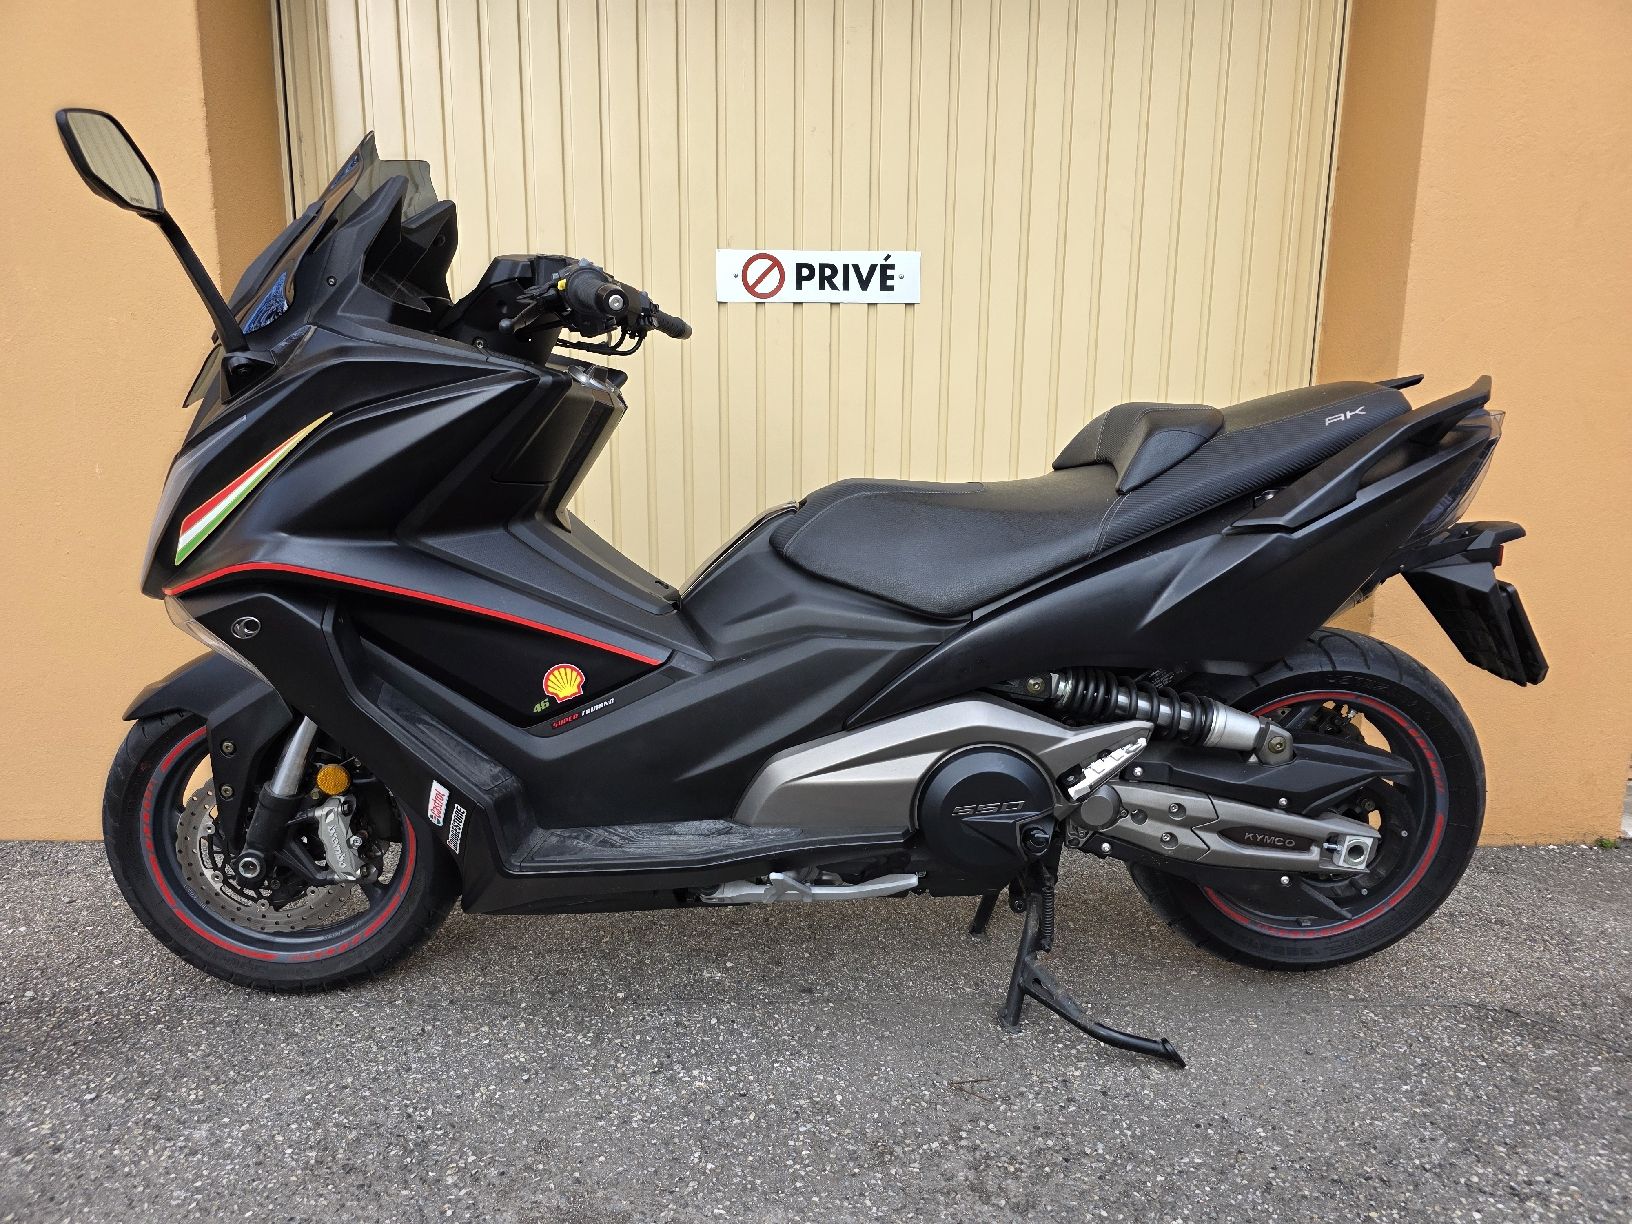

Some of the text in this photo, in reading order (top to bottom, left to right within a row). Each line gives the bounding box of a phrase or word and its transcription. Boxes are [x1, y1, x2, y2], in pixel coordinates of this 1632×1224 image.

[795, 253, 896, 292] PRIVÉ
[1325, 405, 1367, 426] AK
[533, 698, 550, 713] 46
[432, 788, 446, 820] Castrol
[951, 800, 1025, 817] 550
[1244, 832, 1296, 848] KYMCO
